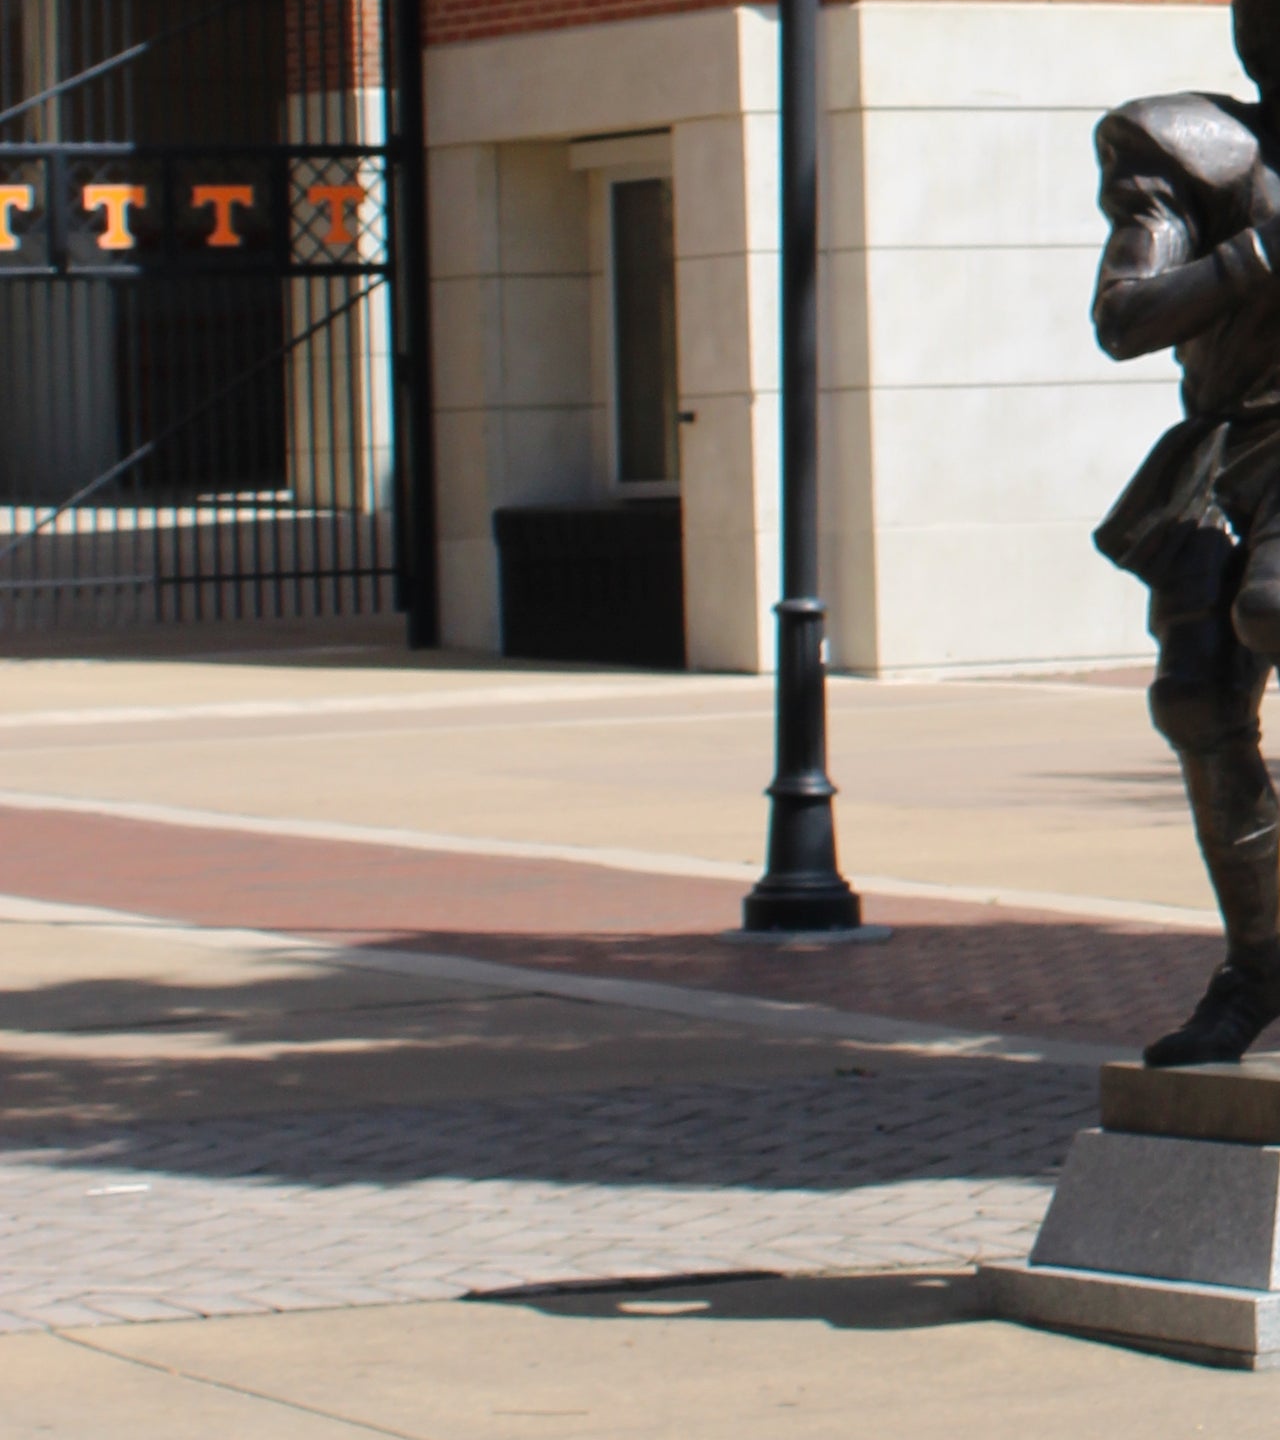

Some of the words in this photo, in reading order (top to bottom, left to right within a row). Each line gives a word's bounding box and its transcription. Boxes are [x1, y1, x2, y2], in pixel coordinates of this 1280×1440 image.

[83, 184, 146, 250] T
[192, 185, 254, 246] T
[308, 185, 365, 245] T
